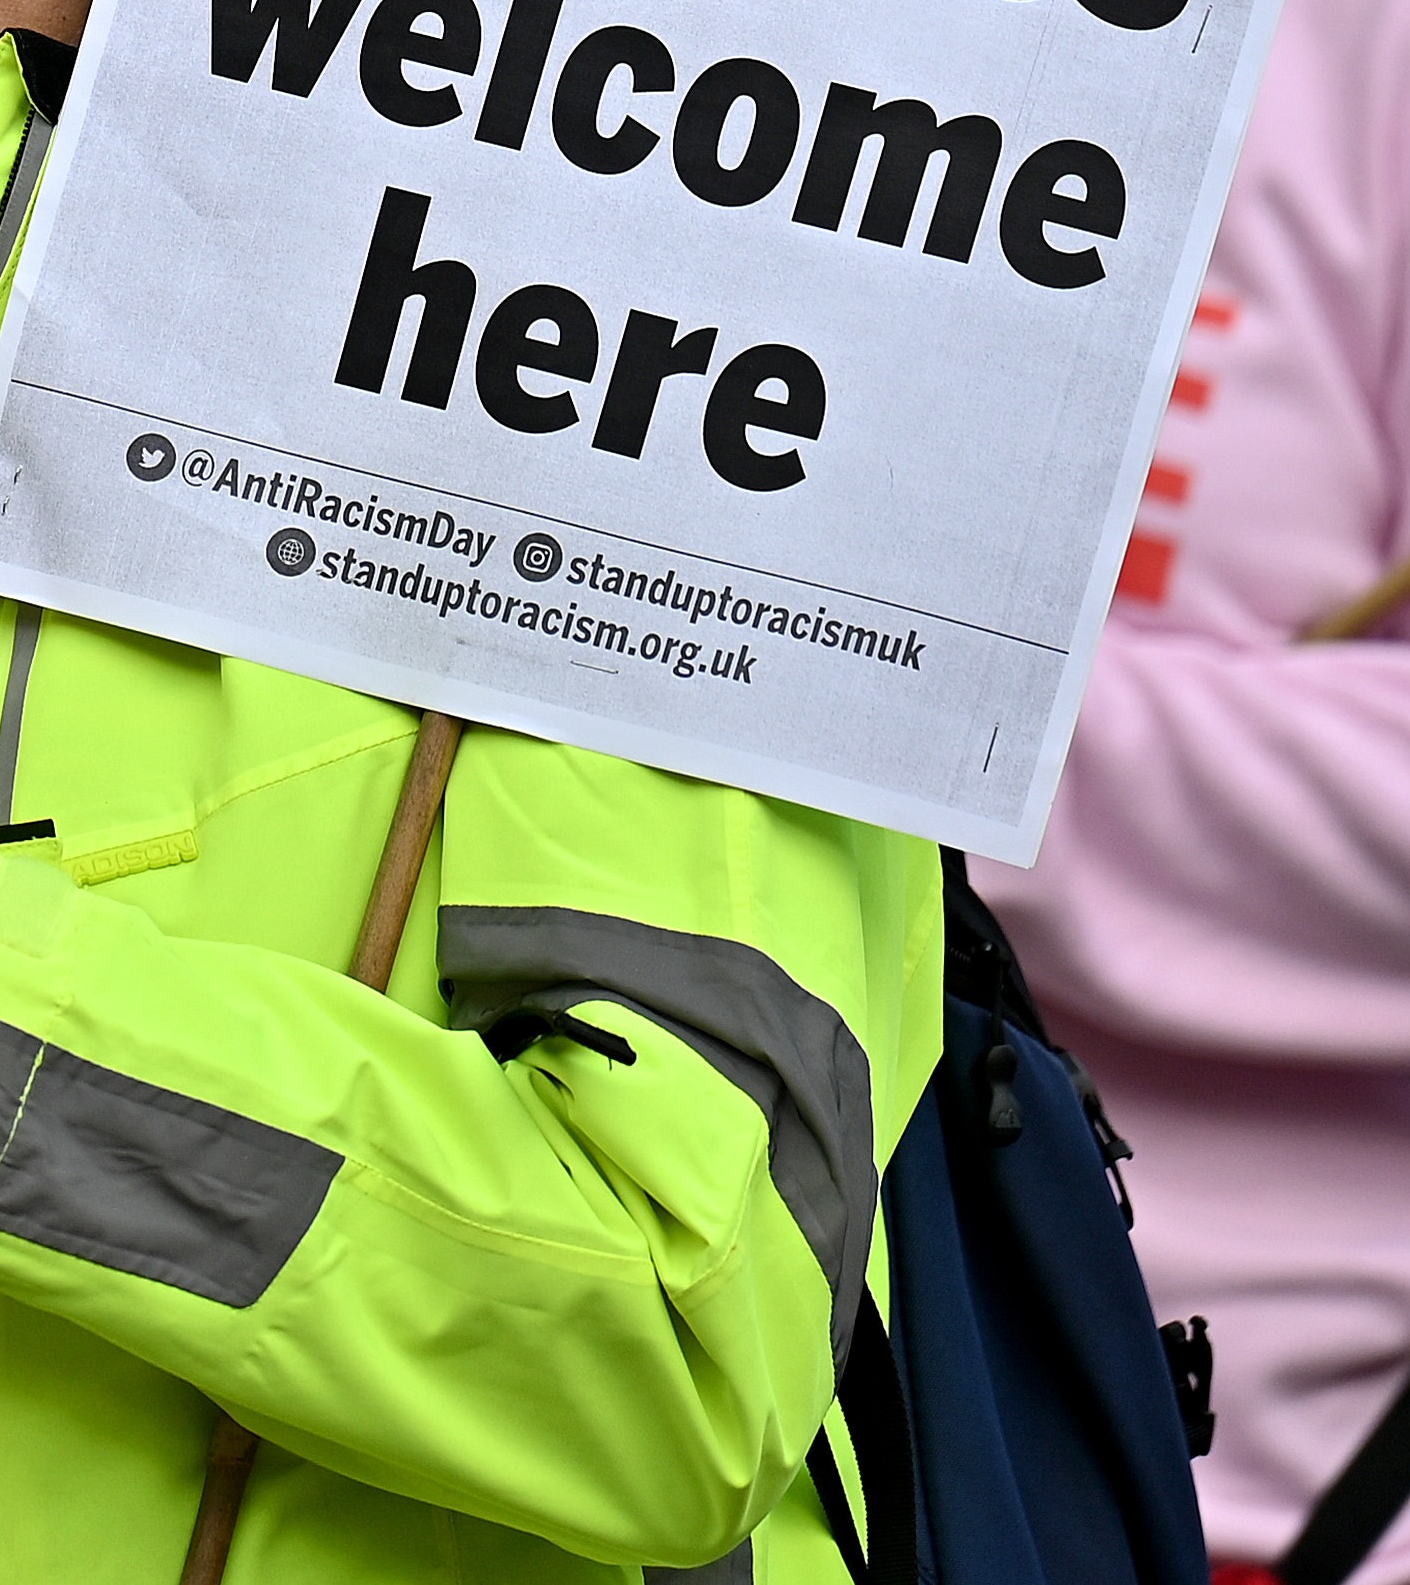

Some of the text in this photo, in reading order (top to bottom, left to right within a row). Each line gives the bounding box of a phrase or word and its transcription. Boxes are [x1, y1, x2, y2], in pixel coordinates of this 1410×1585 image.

[332, 184, 828, 494] here
[181, 448, 927, 671] @AntiRacismDay standuptoracismuk
[319, 546, 758, 686] standuptoracism.org.uk
[71, 832, 199, 886] ADISON
